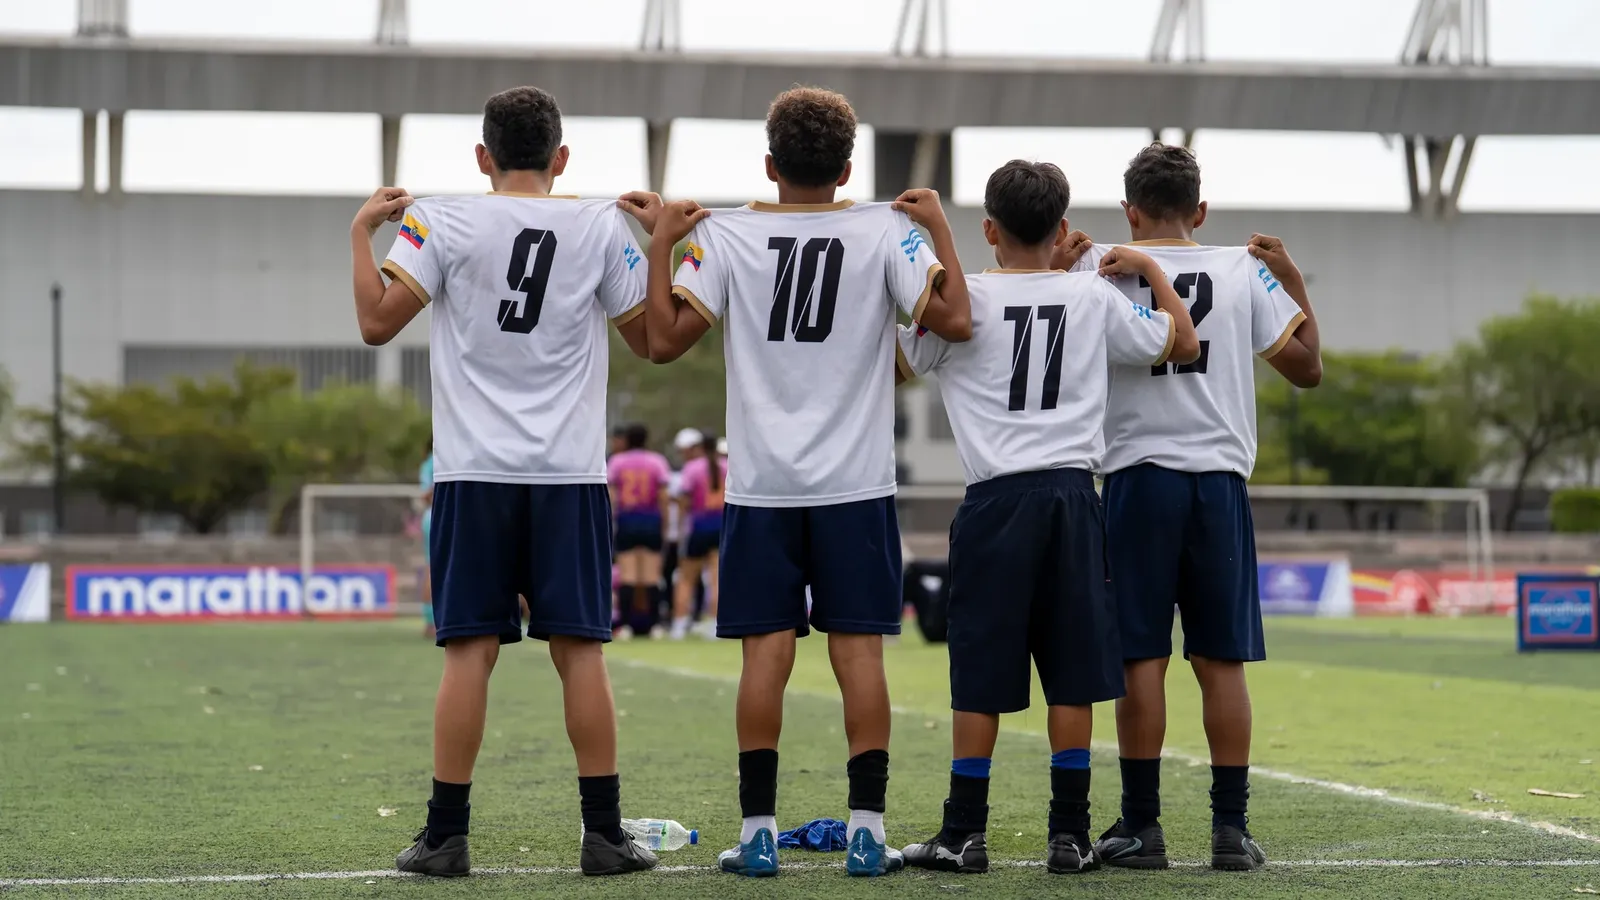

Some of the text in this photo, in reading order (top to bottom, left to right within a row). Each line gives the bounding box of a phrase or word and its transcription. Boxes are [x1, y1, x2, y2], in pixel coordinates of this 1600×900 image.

[497, 228, 557, 334] 9
[767, 237, 845, 342] 10
[1139, 272, 1213, 375] 2
[1003, 305, 1066, 411] 11
[87, 569, 376, 615] marathon
